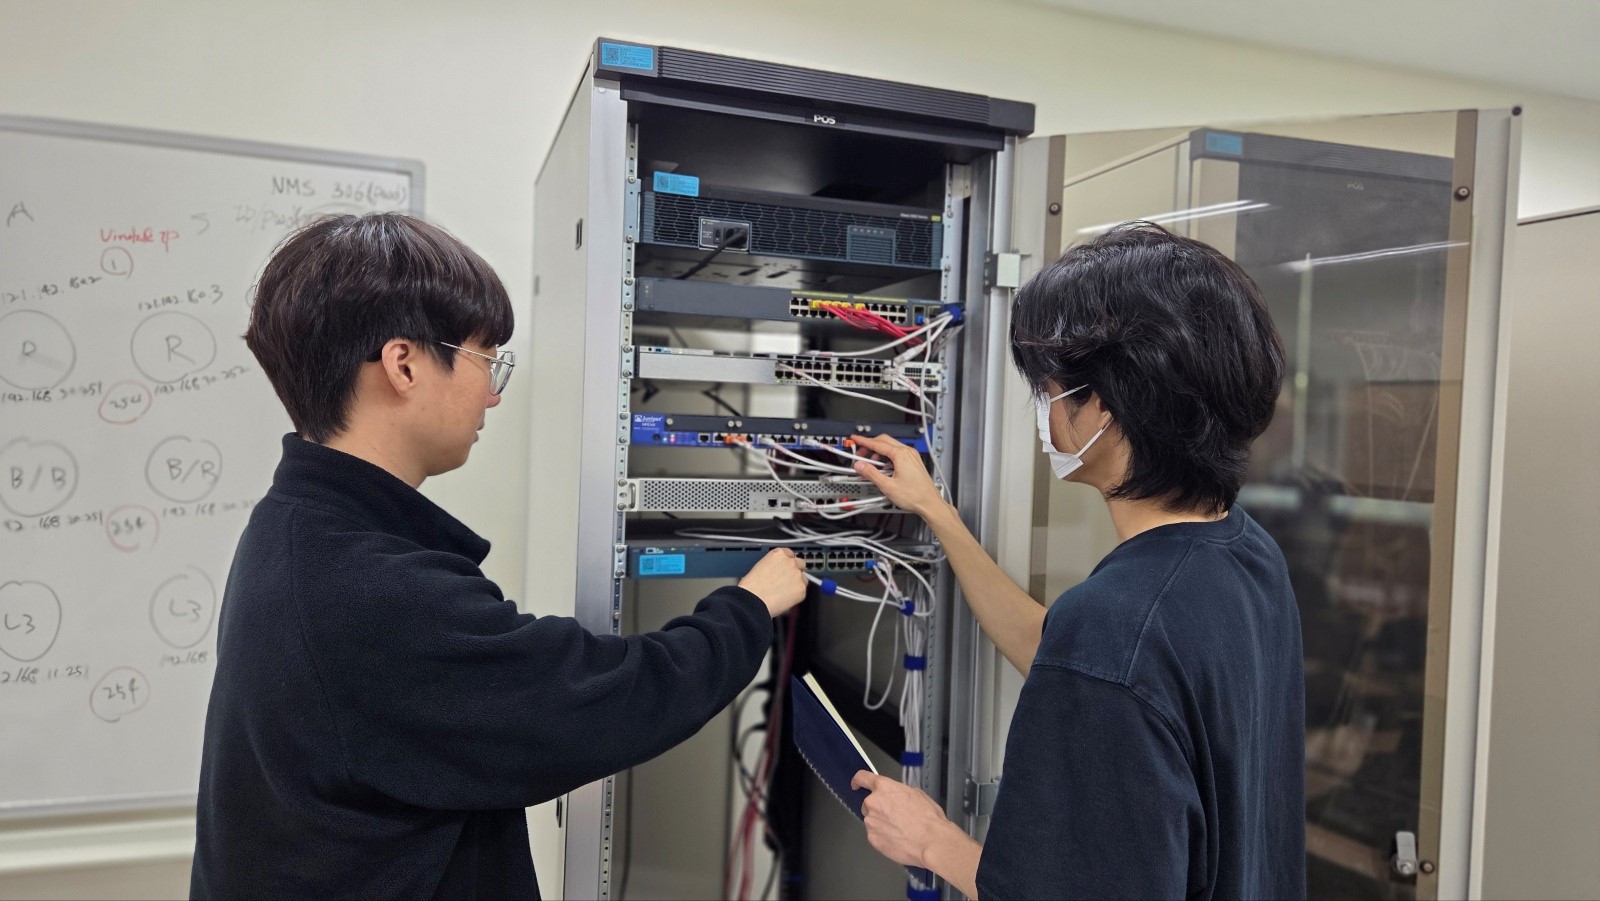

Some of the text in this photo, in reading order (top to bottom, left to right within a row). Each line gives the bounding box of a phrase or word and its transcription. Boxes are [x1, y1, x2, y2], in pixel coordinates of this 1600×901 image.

[813, 114, 836, 125] POS
[271, 176, 316, 198] NMS
[6, 202, 34, 228] A
[165, 335, 197, 366] R
